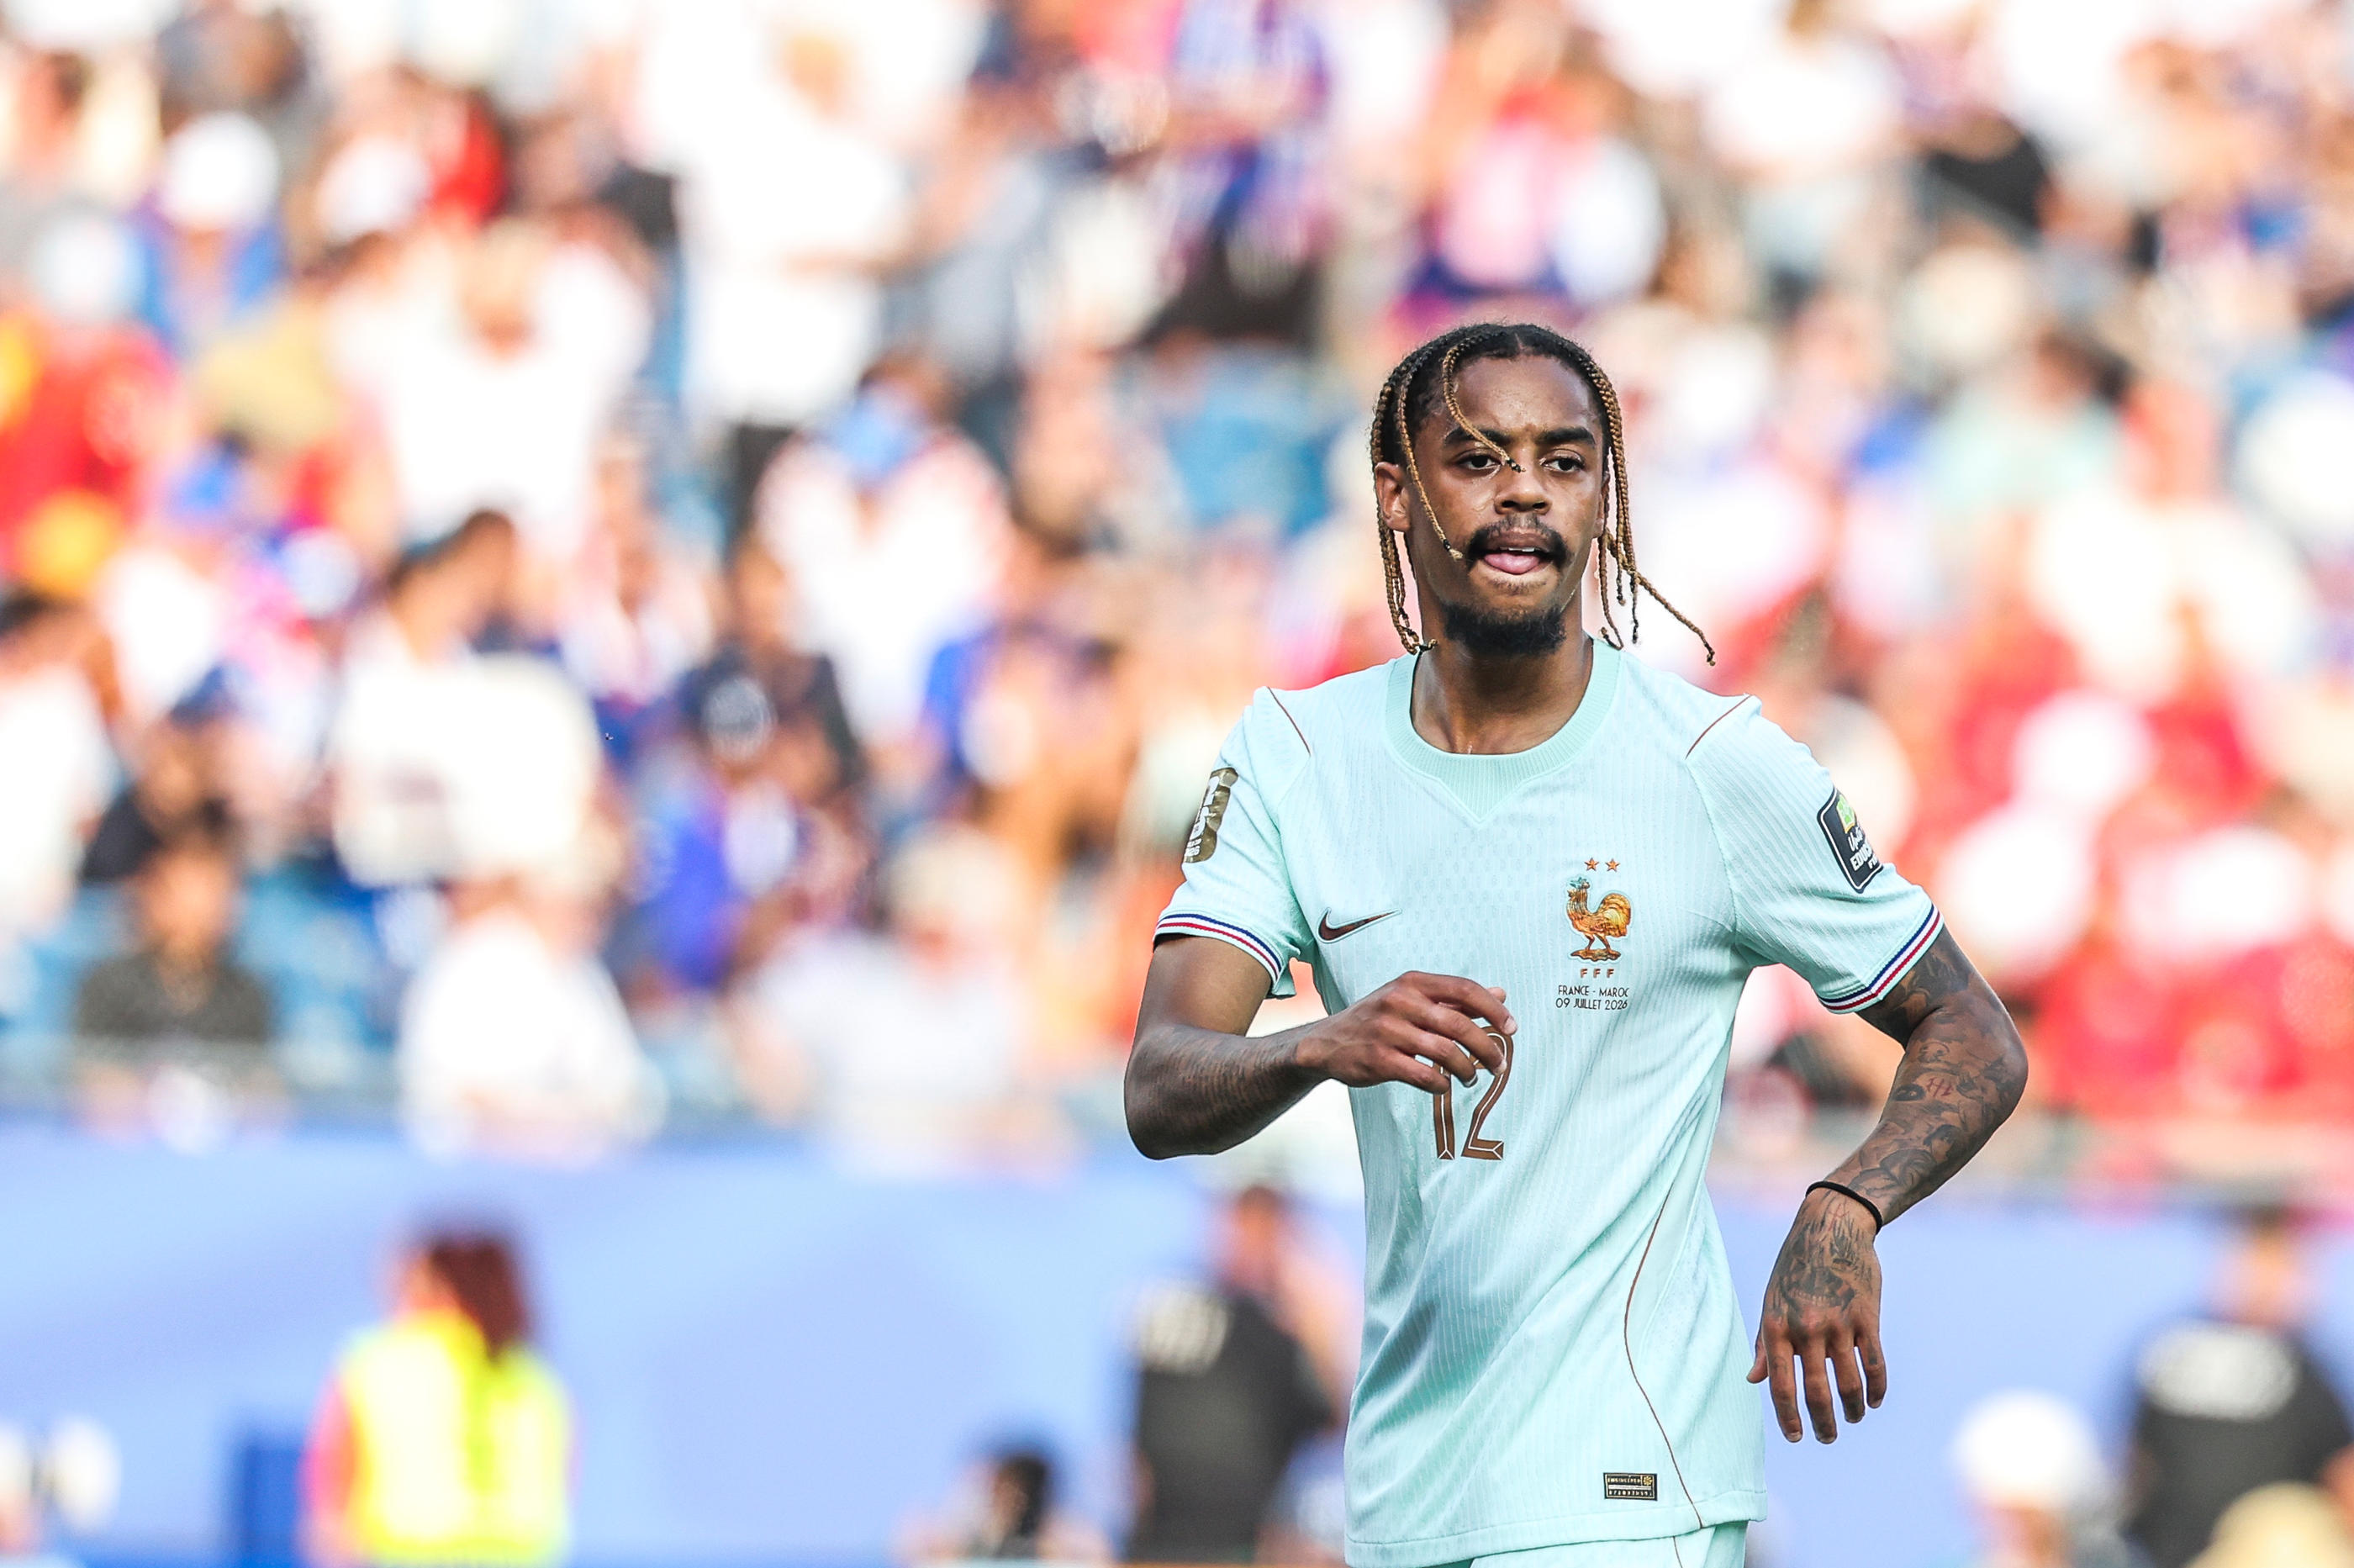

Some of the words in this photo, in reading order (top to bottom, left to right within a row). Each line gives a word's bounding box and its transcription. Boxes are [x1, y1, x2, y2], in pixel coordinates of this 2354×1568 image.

[1558, 985, 1590, 996] FRANCE
[1599, 987, 1629, 998] MAROC
[1555, 997, 1570, 1009] 09
[1574, 998, 1602, 1010] JUILLET
[1604, 999, 1628, 1011] 2026
[1433, 1025, 1513, 1160] 12
